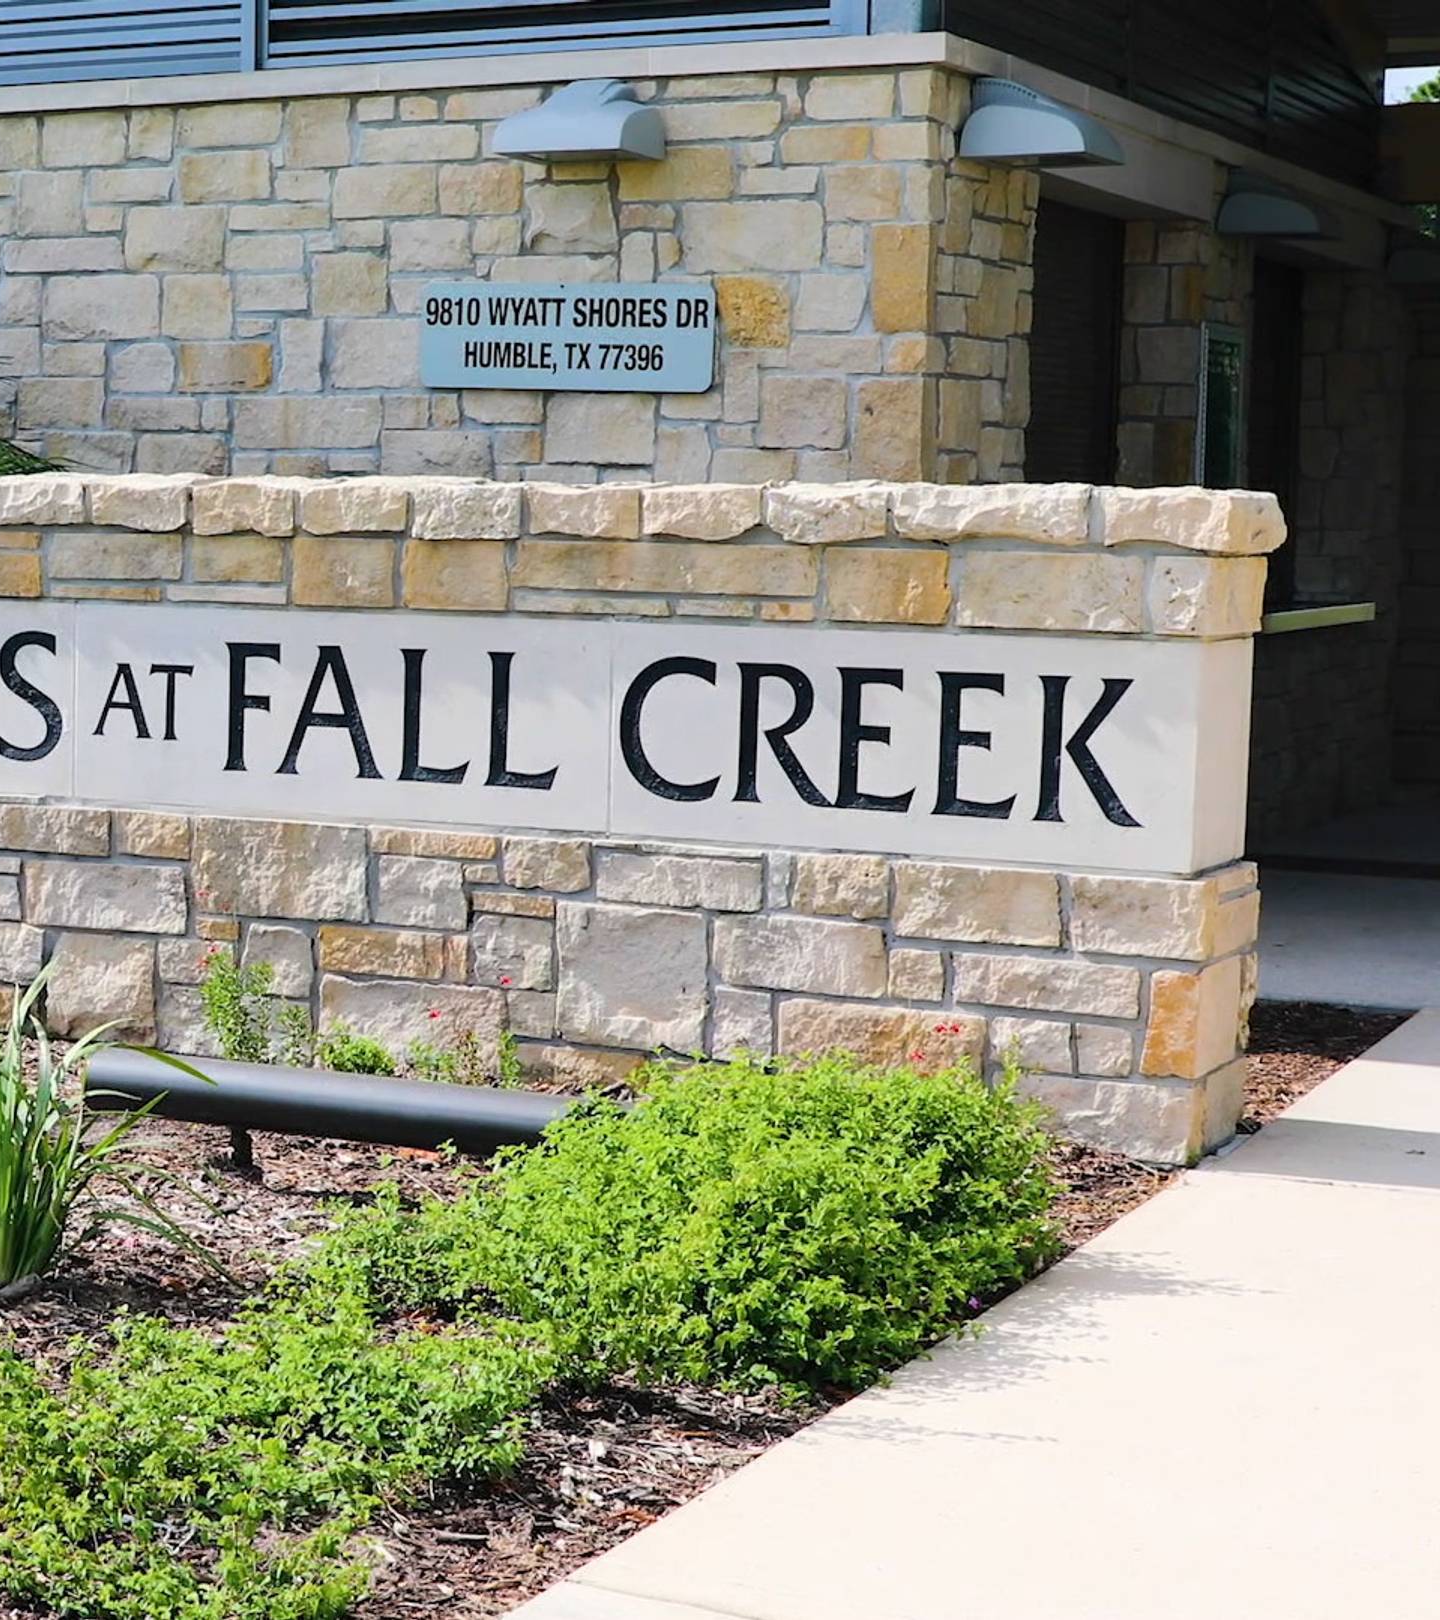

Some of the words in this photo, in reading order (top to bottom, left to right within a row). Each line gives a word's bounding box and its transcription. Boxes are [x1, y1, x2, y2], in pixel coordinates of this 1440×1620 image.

[426, 297, 481, 326] 9810
[488, 297, 566, 327] WYATT
[572, 298, 668, 329] SHORES
[675, 298, 709, 329] DR
[464, 341, 558, 375] HUMBLE,
[563, 342, 592, 370] TX
[598, 343, 664, 372] 77396
[91, 662, 196, 742] AT
[222, 640, 560, 791] FALL
[618, 654, 1143, 829] CREEK
